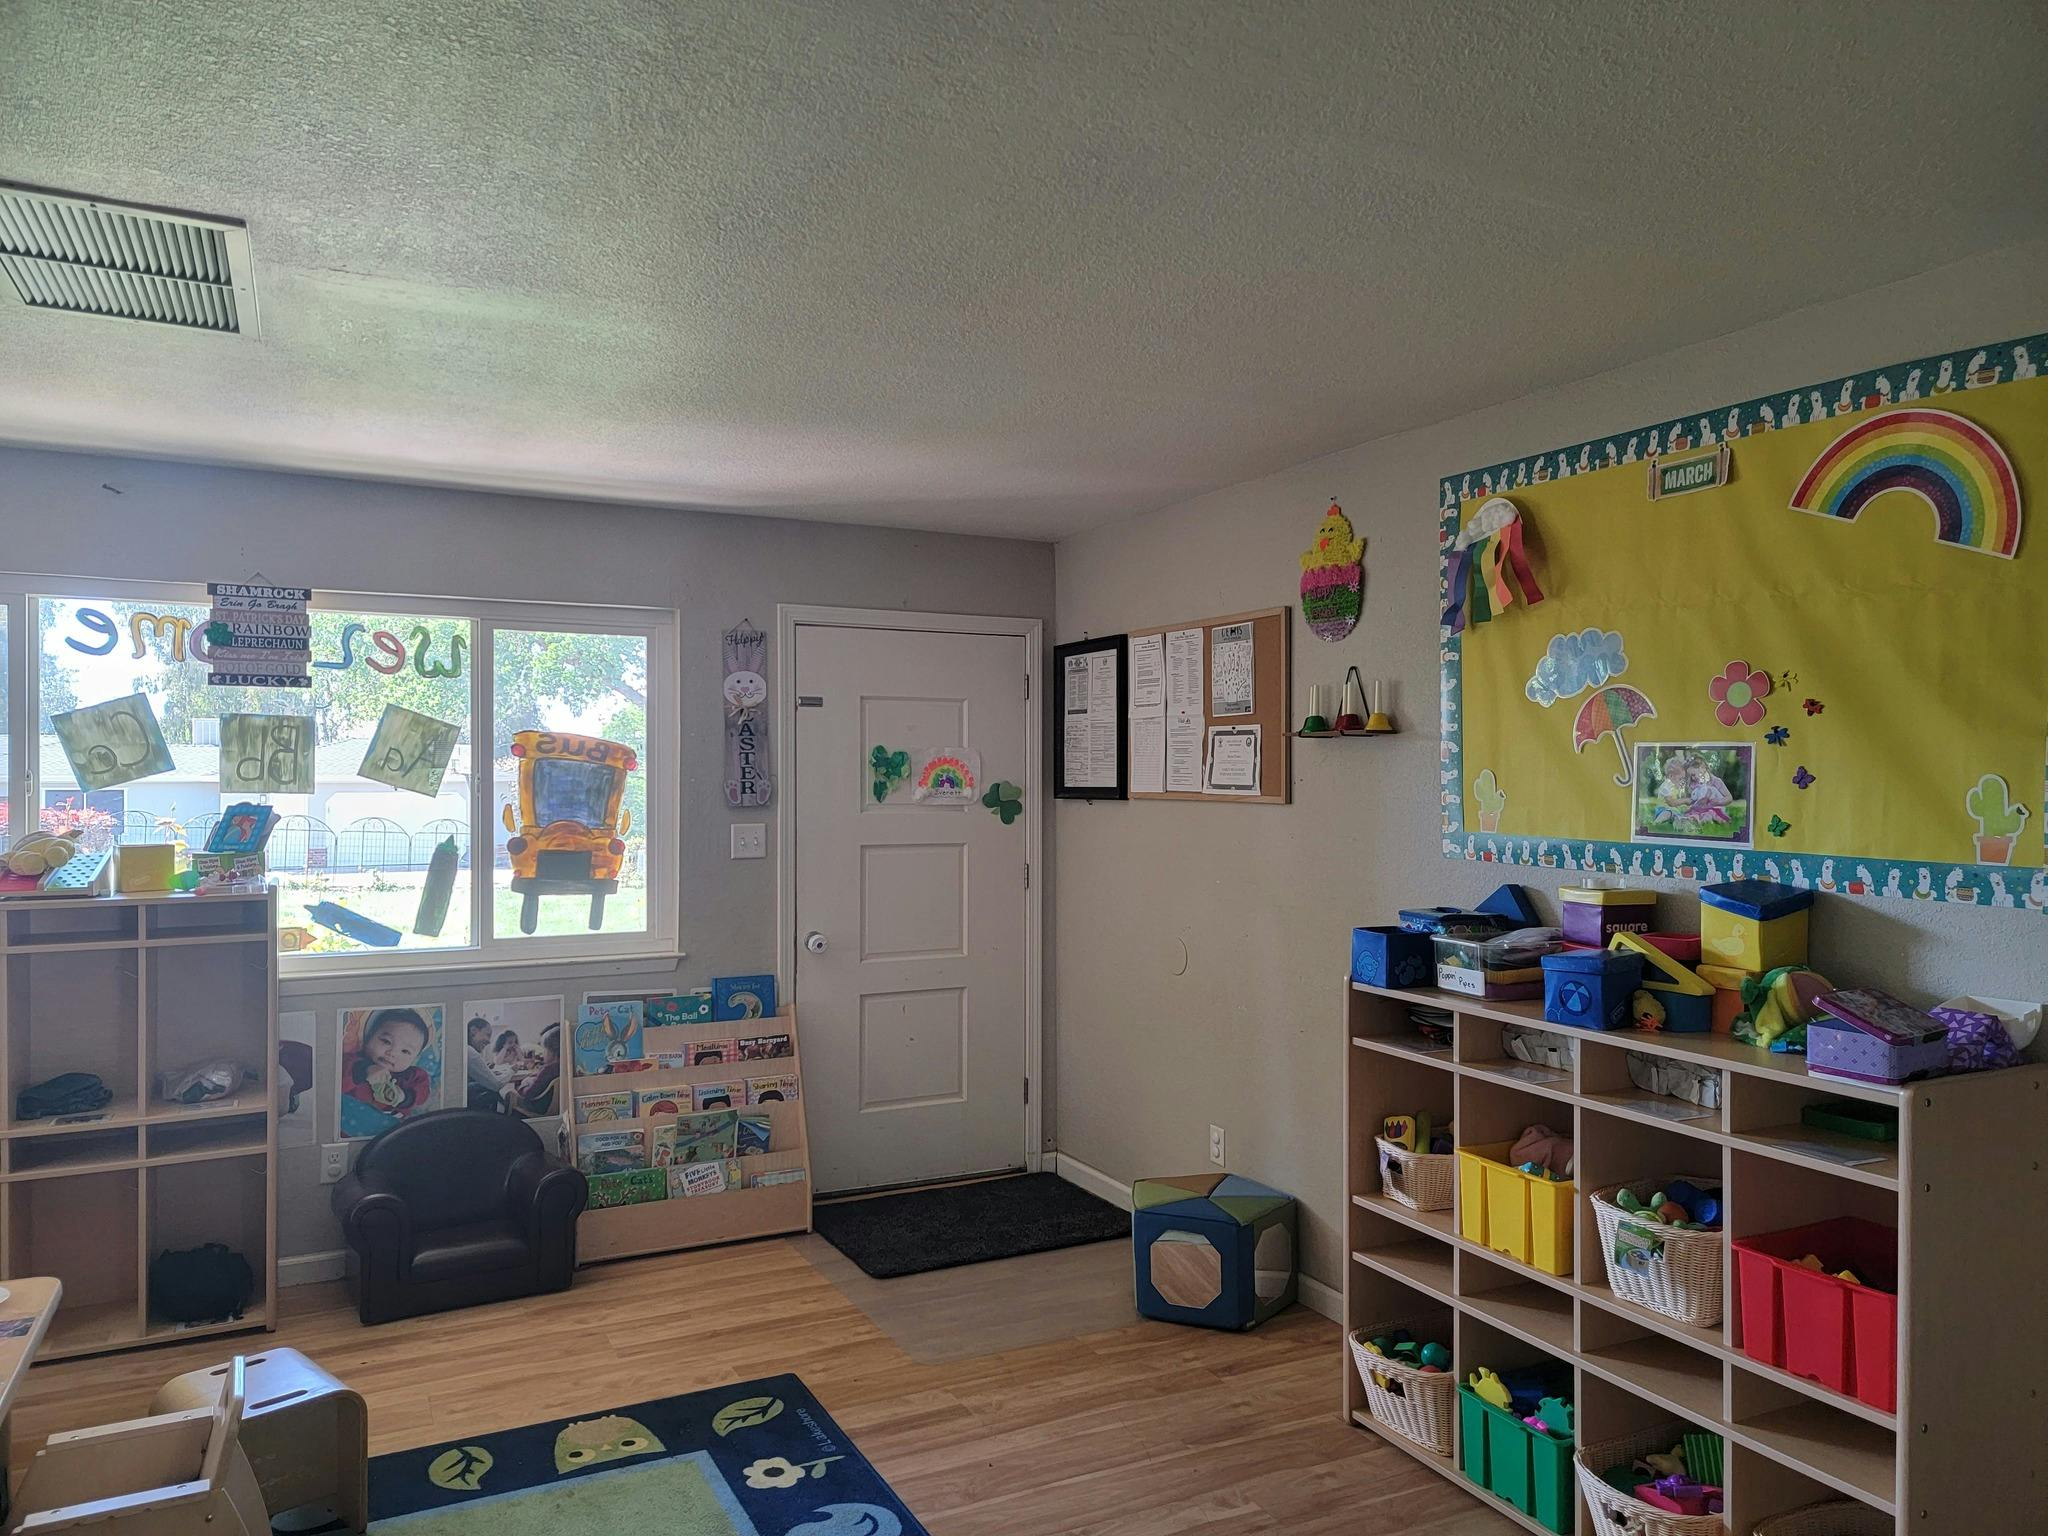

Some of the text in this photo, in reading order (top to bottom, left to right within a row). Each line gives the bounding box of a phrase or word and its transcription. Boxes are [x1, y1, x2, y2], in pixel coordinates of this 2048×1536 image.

[1665, 462, 1713, 490] MARCH
[217, 585, 305, 600] SHAMROCK
[220, 598, 298, 611] Erin Go Bragh
[233, 613, 283, 624] PATRICK'S
[286, 615, 305, 625] DAY
[232, 623, 309, 637] RAINBOW
[232, 637, 303, 650] LEPRECHAUN
[725, 633, 765, 648] Happy
[246, 663, 263, 673] OF
[266, 664, 302, 675] GOLD
[225, 675, 295, 687] LUCKY
[1606, 922, 1648, 934] square
[1459, 976, 1476, 989] Pipes
[617, 1005, 633, 1014] Cat
[681, 1012, 698, 1020] Ball
[758, 1036, 788, 1044] Barnyard
[698, 1087, 726, 1096] Listening
[752, 1081, 778, 1090] Sharing
[581, 1097, 628, 1108] Manners Time
[685, 1169, 700, 1179] FIVE
[688, 1170, 717, 1185] MONKEYS
